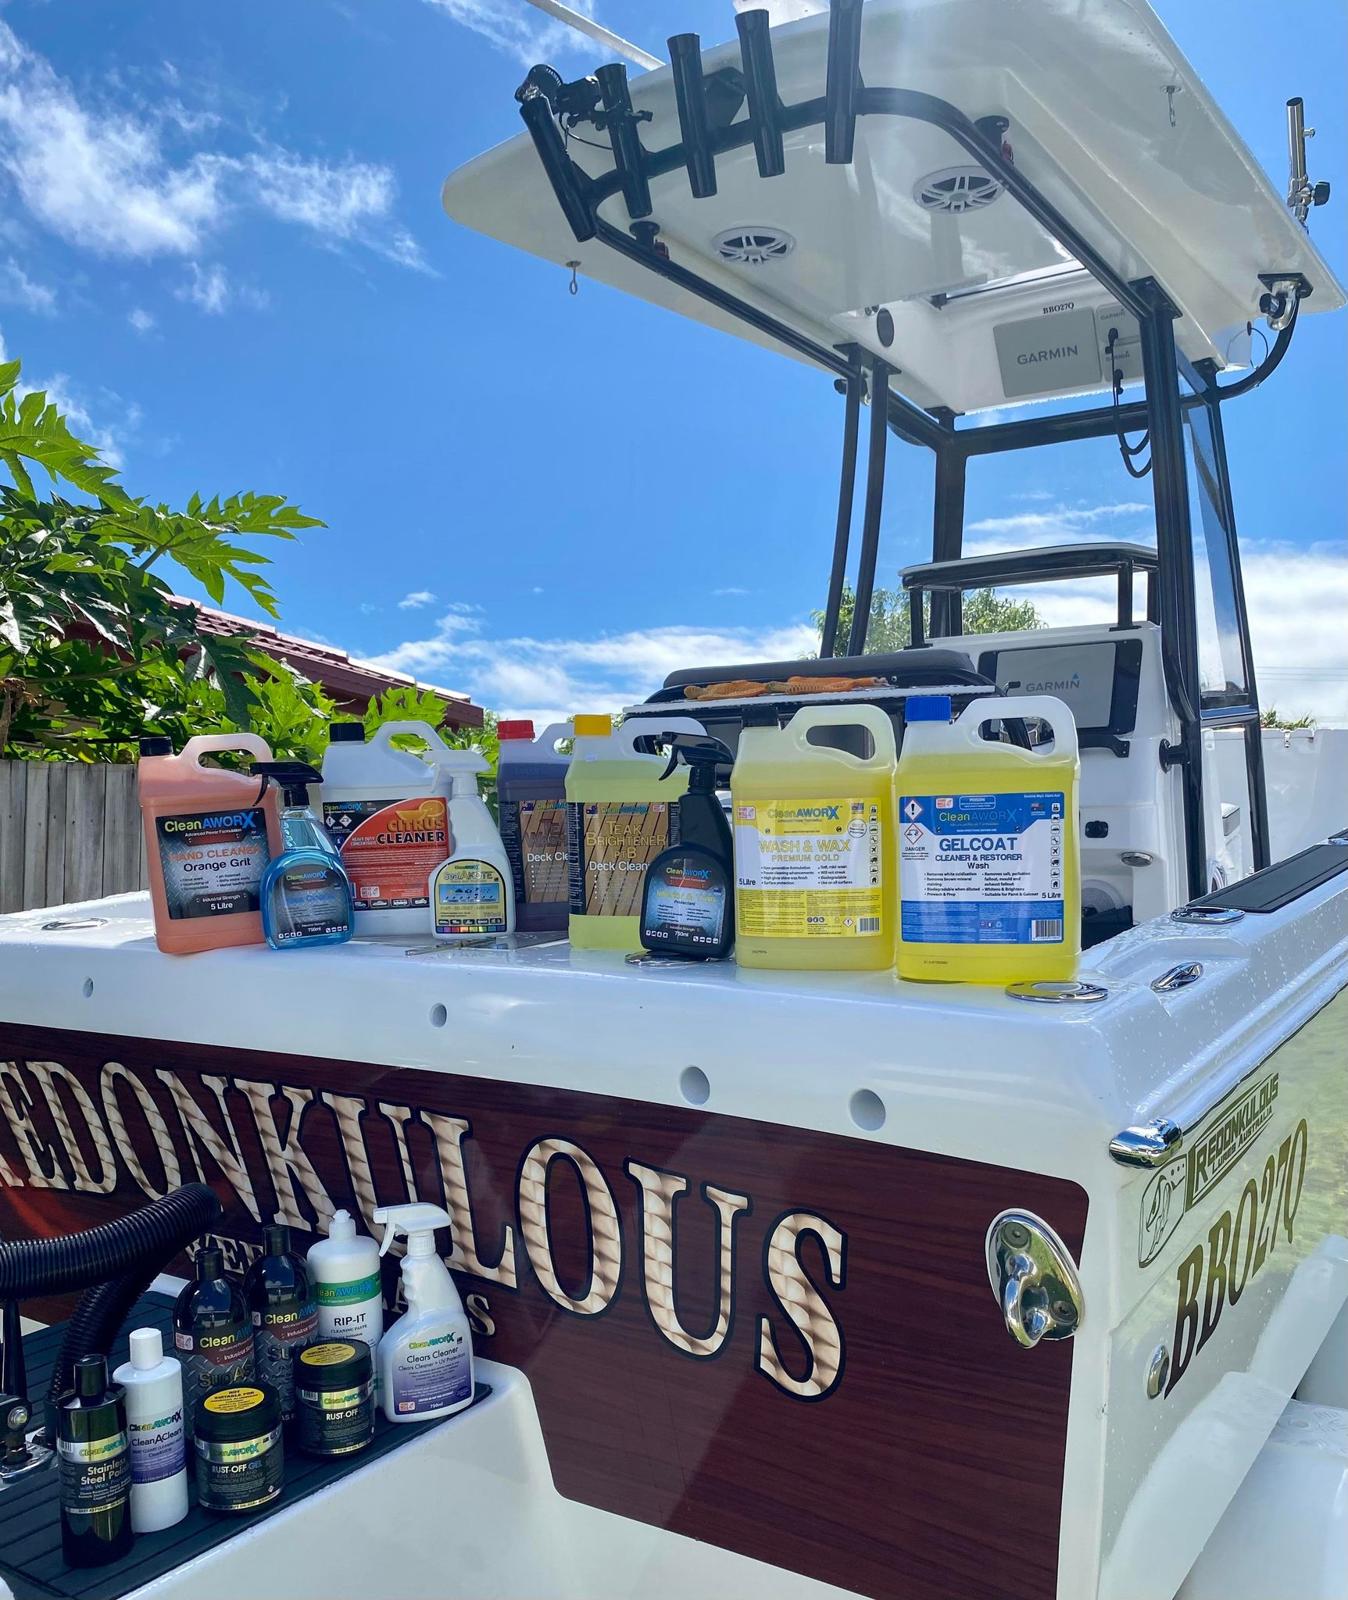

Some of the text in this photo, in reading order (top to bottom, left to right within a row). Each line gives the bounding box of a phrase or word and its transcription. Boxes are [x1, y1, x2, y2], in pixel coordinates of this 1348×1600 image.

[1017, 346, 1079, 365] GARMIN
[1026, 680, 1079, 692] GARMIN
[767, 805, 841, 820] CleanAWORX
[939, 809, 1018, 823] CleanAWORX
[387, 819, 445, 832] CITRUS
[376, 831, 445, 845] CLEANER
[586, 832, 666, 846] BRIGHTENER
[939, 837, 1018, 851] GELCOAT
[170, 845, 260, 861] HAND CLEANER
[760, 840, 851, 852] WASH & WAX
[527, 852, 552, 862] Deck
[815, 854, 840, 862] GOLD
[935, 853, 971, 862] CLEANER
[972, 853, 979, 861] &
[979, 853, 1023, 861] RESTORER
[183, 858, 252, 872] Orange Grit
[589, 861, 650, 871] Deck Clean
[967, 862, 990, 870] Wash
[217, 902, 233, 910] Litre
[1194, 1073, 1279, 1194] REDONKULOUS
[0, 1061, 842, 1397] EDONKULOUS
[334, 1313, 366, 1327] RIP-IT
[406, 1347, 459, 1364] Clears Cleaner
[326, 1407, 359, 1421] RUST-OFF
[211, 1463, 247, 1474] RUST-OFF
[80, 1476, 106, 1486] Steel
